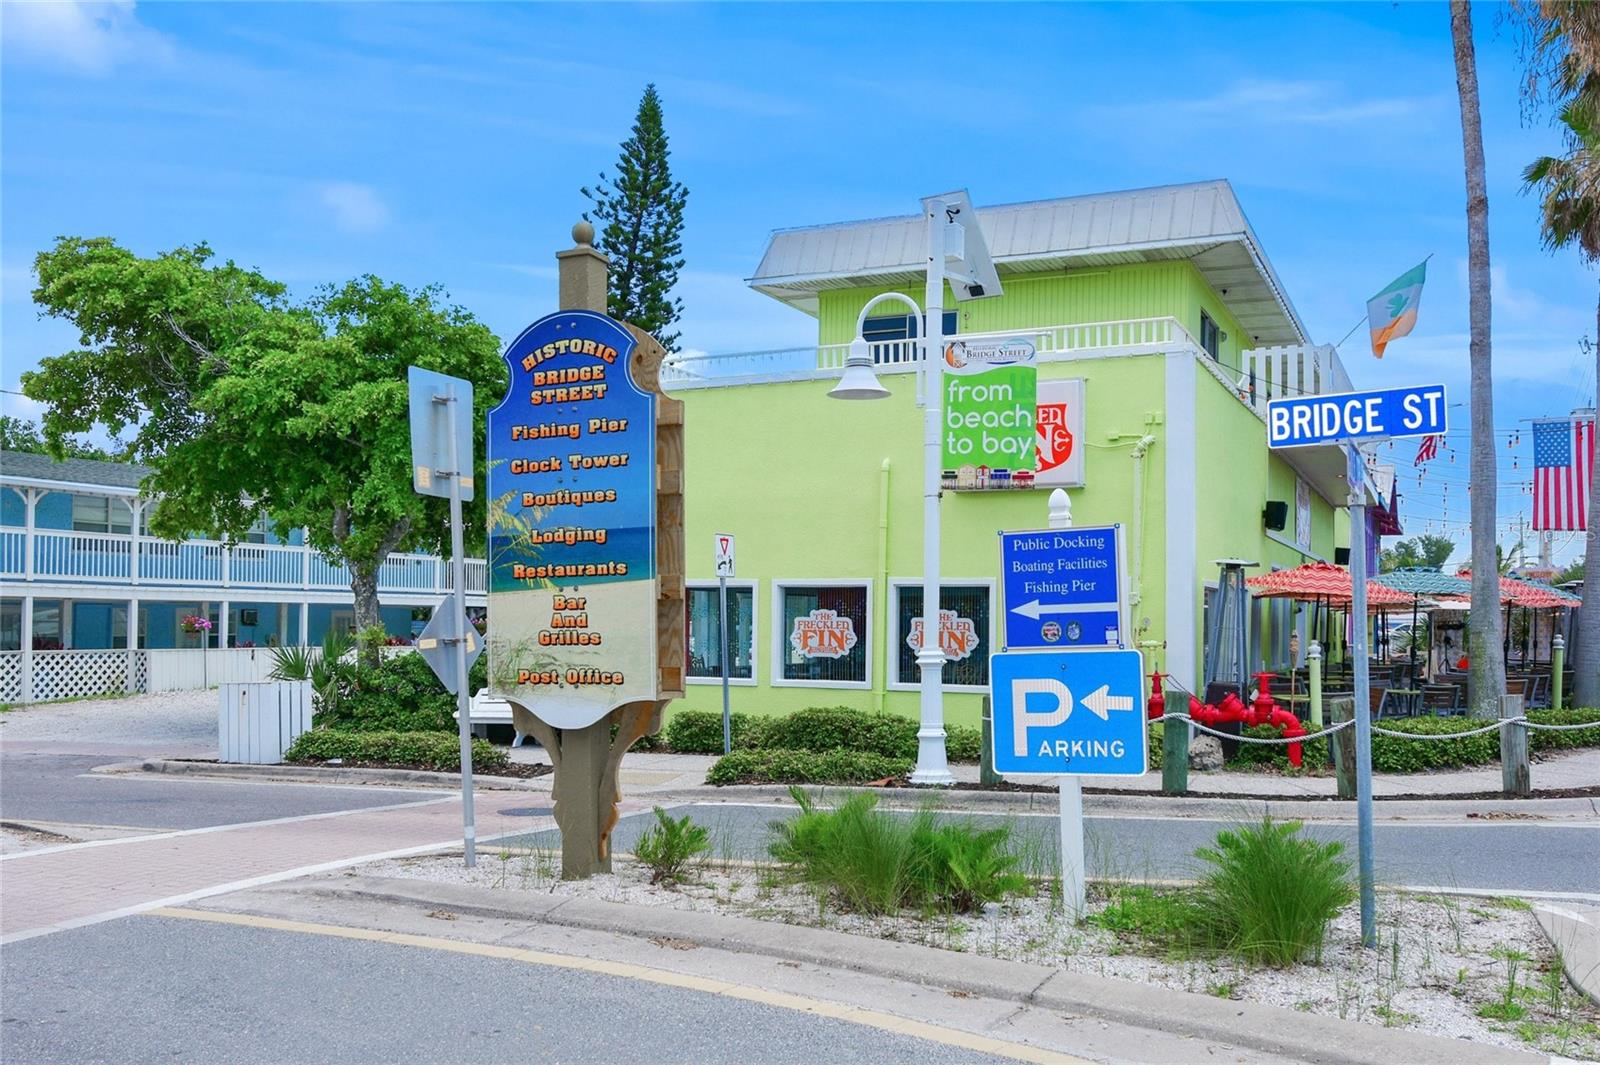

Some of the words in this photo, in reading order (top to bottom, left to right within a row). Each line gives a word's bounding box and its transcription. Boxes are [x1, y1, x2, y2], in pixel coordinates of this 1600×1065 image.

[521, 339, 618, 372] HISTORIC
[533, 365, 604, 387] BRIDGE
[530, 384, 608, 406] STREET
[947, 379, 1012, 402] from
[947, 403, 1032, 429] beach
[1271, 397, 1384, 441] BRIDGE
[1402, 391, 1442, 430] ST
[511, 421, 580, 441] Fishing
[589, 418, 628, 435] Pier
[946, 432, 973, 454] to
[982, 431, 1033, 460] bay
[510, 456, 562, 475] Clock
[569, 453, 629, 470] Tower
[522, 488, 617, 507] Boutiques
[531, 527, 608, 545] Lodging
[1013, 538, 1050, 552] Public
[1053, 535, 1105, 551] Docking
[513, 561, 628, 580] Restaurants
[1012, 560, 1055, 575] Boating
[1057, 557, 1108, 571] Facilities
[1024, 580, 1069, 596] Fishing
[1072, 579, 1097, 593] Pier
[552, 594, 586, 611] Bar
[550, 612, 588, 629] And
[797, 620, 850, 631] FRECKLED
[813, 612, 834, 621] THE
[538, 629, 602, 646] Grilles
[801, 629, 846, 652] FIN
[518, 669, 559, 685] Post
[565, 669, 625, 685] Office
